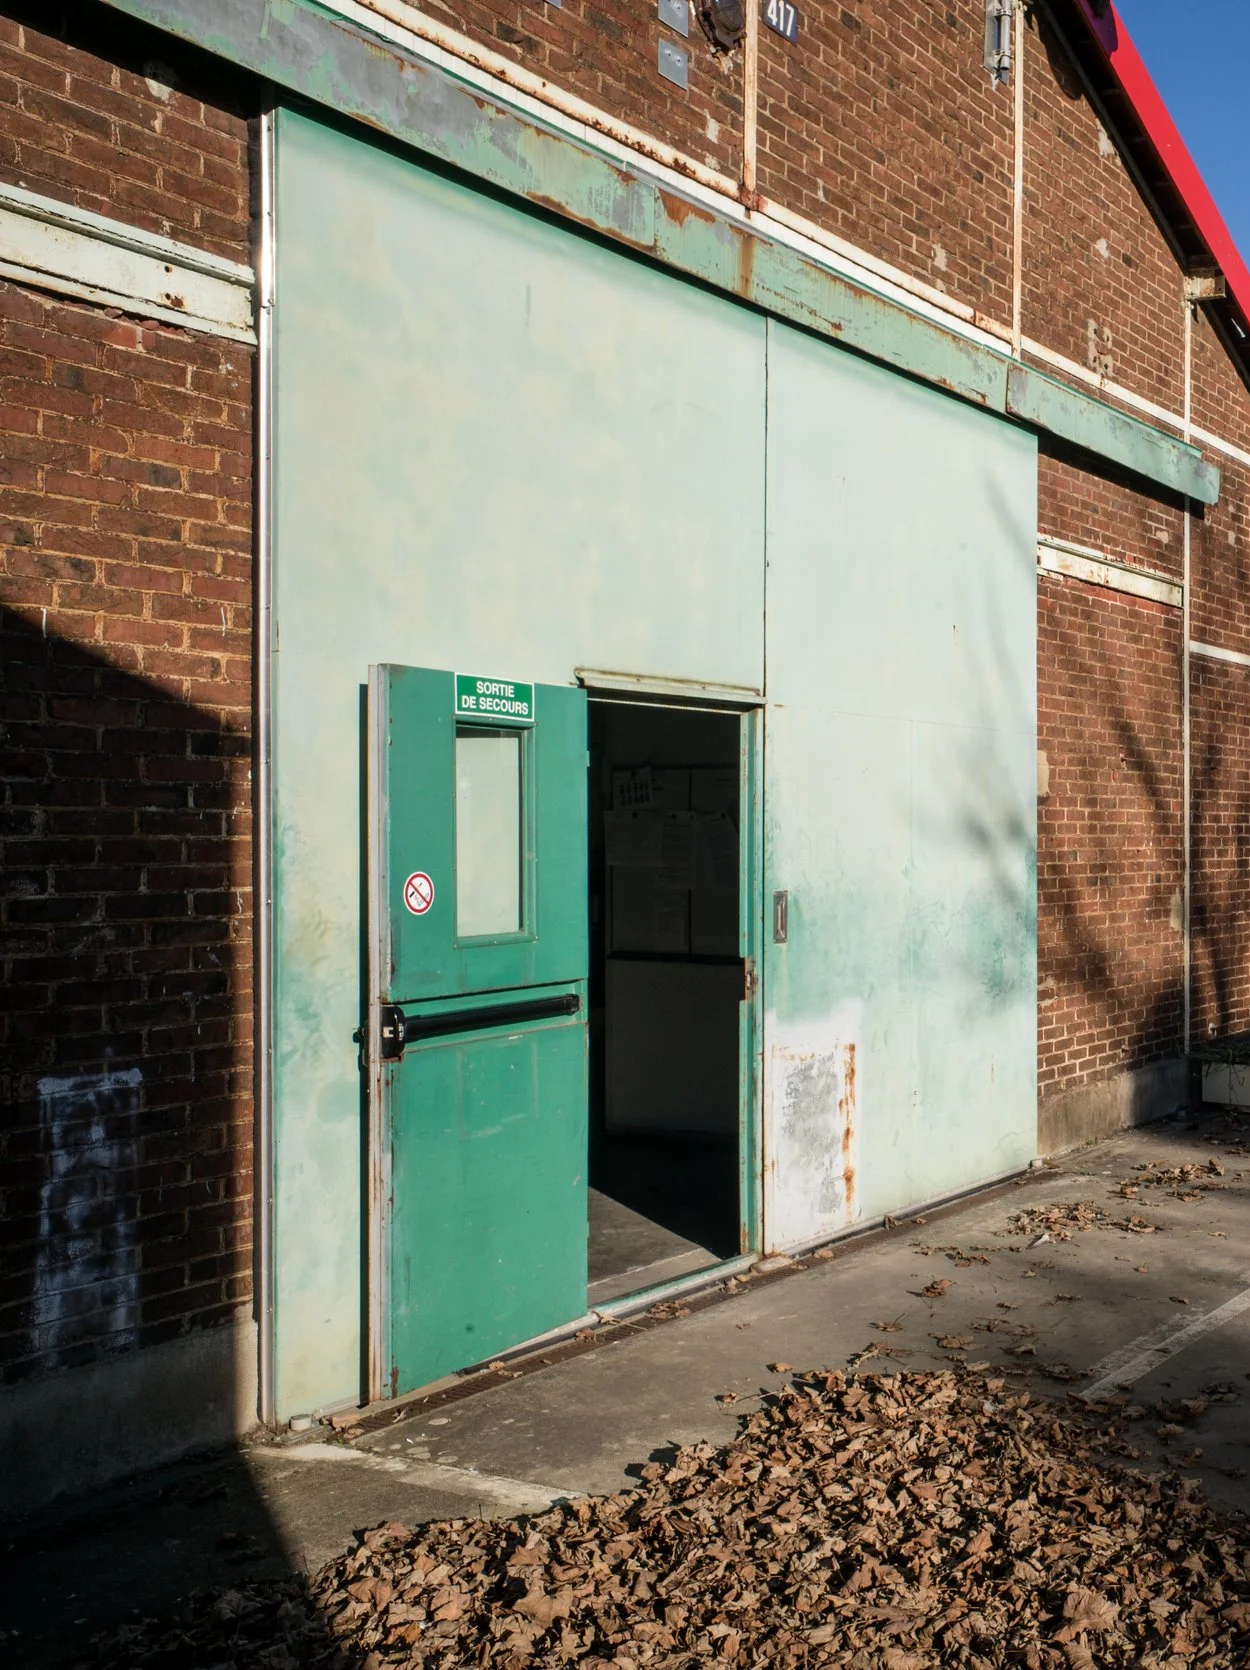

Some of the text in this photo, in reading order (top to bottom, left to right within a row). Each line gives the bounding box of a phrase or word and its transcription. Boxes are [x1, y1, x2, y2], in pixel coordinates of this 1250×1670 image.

[767, 0, 794, 37] 417
[476, 681, 515, 697] SORTIE
[461, 695, 529, 715] DE SECOURS
